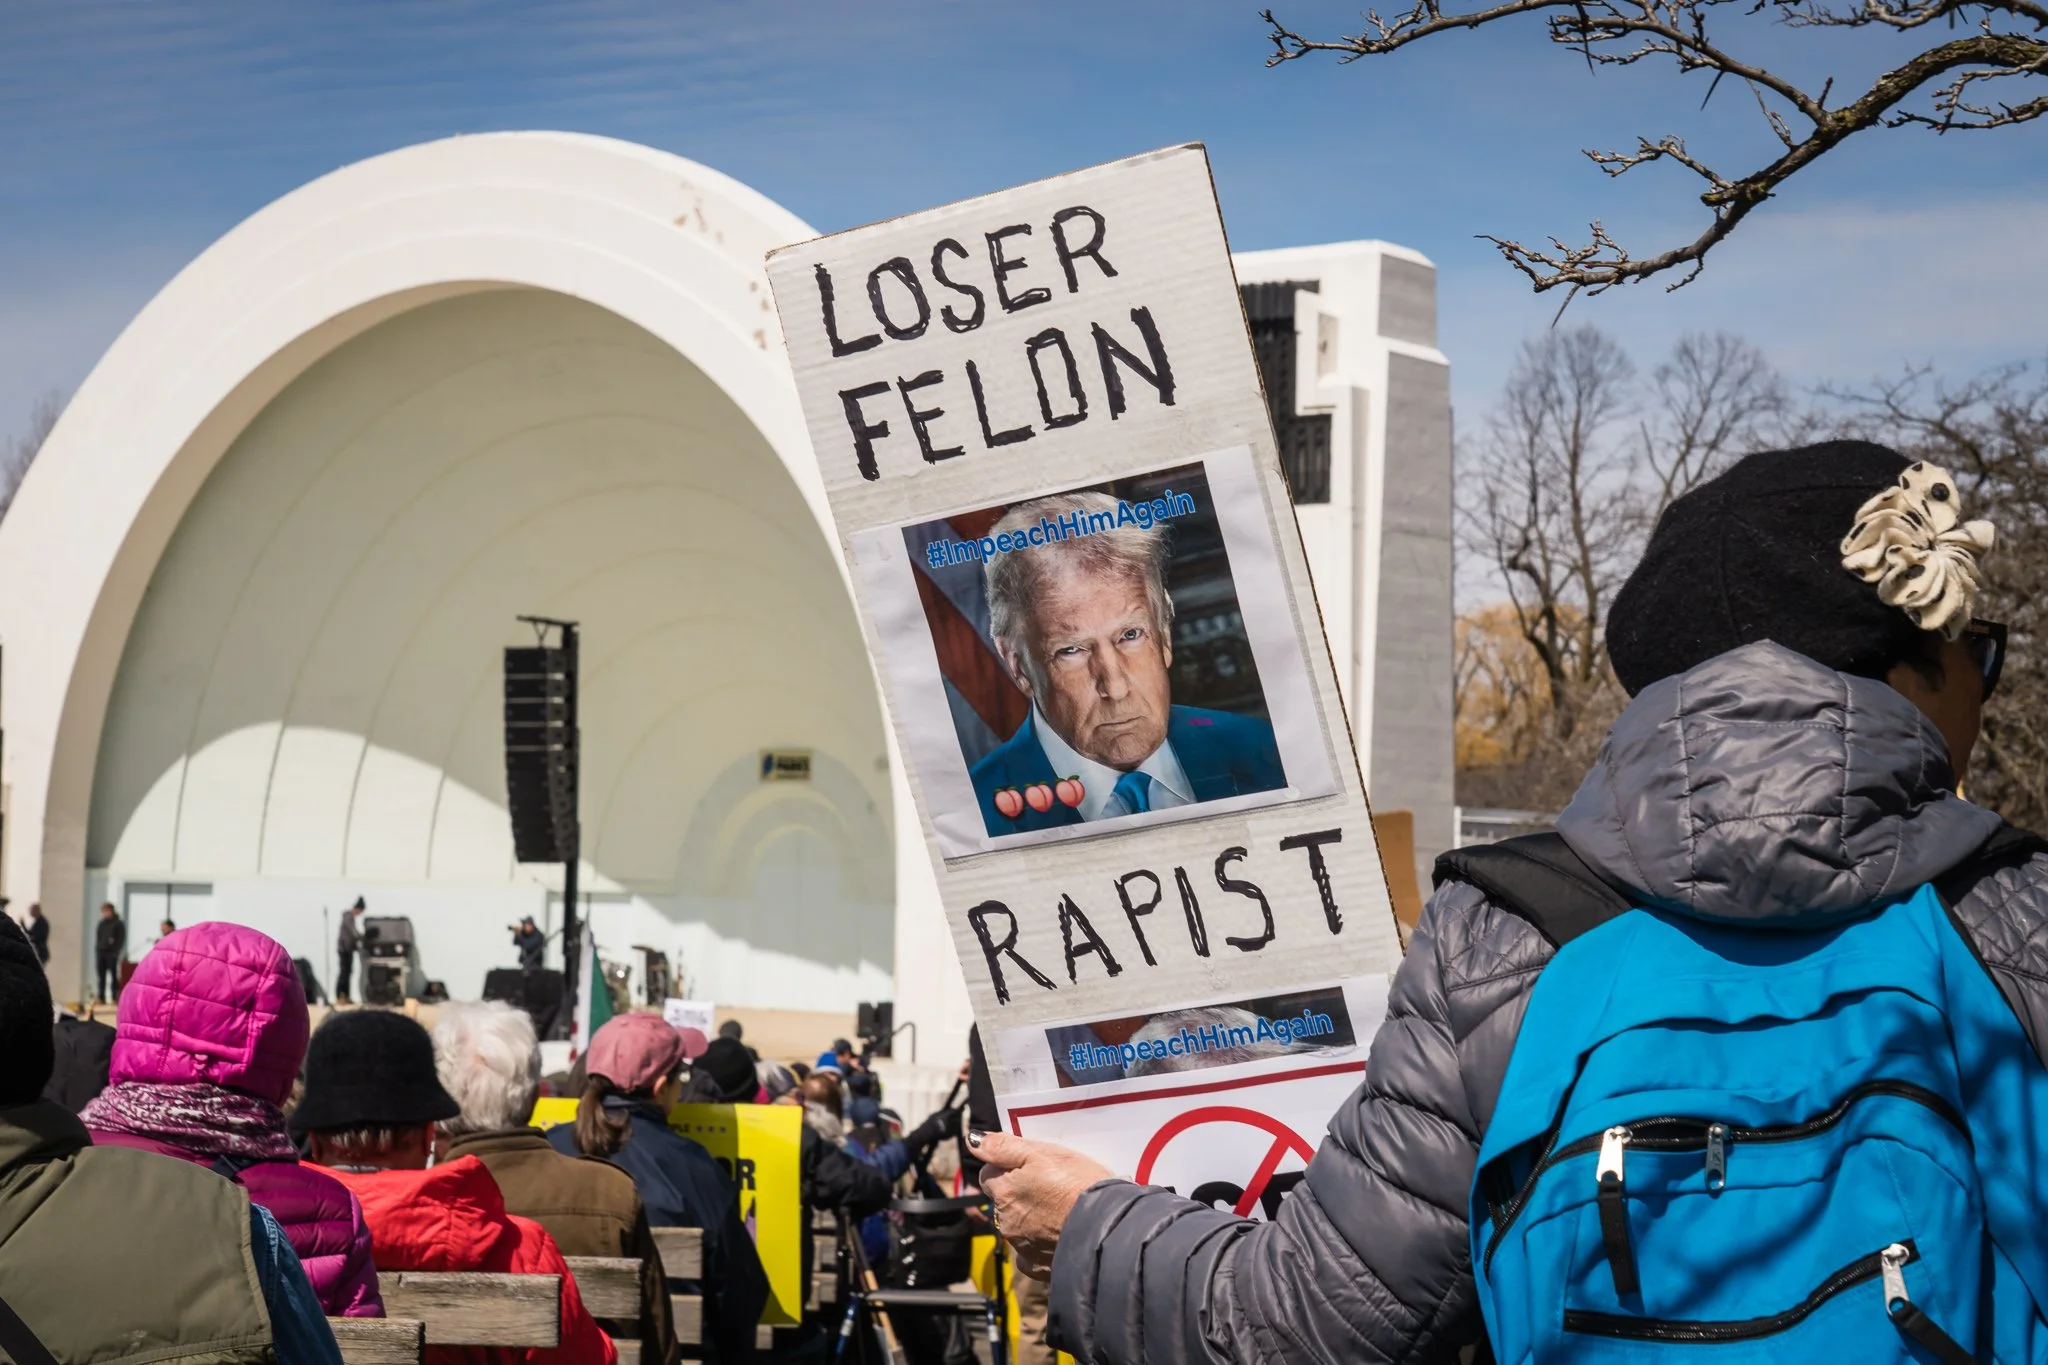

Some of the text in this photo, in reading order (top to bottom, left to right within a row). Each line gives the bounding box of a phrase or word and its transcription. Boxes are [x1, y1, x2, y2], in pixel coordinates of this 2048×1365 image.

[814, 205, 1119, 357] LOSER
[837, 306, 1176, 482] FELON
[926, 488, 1197, 569] #ImpeachHimAgain
[967, 827, 1343, 1006] RAPIST
[1069, 1009, 1335, 1071] #ImpeachHimAgain
